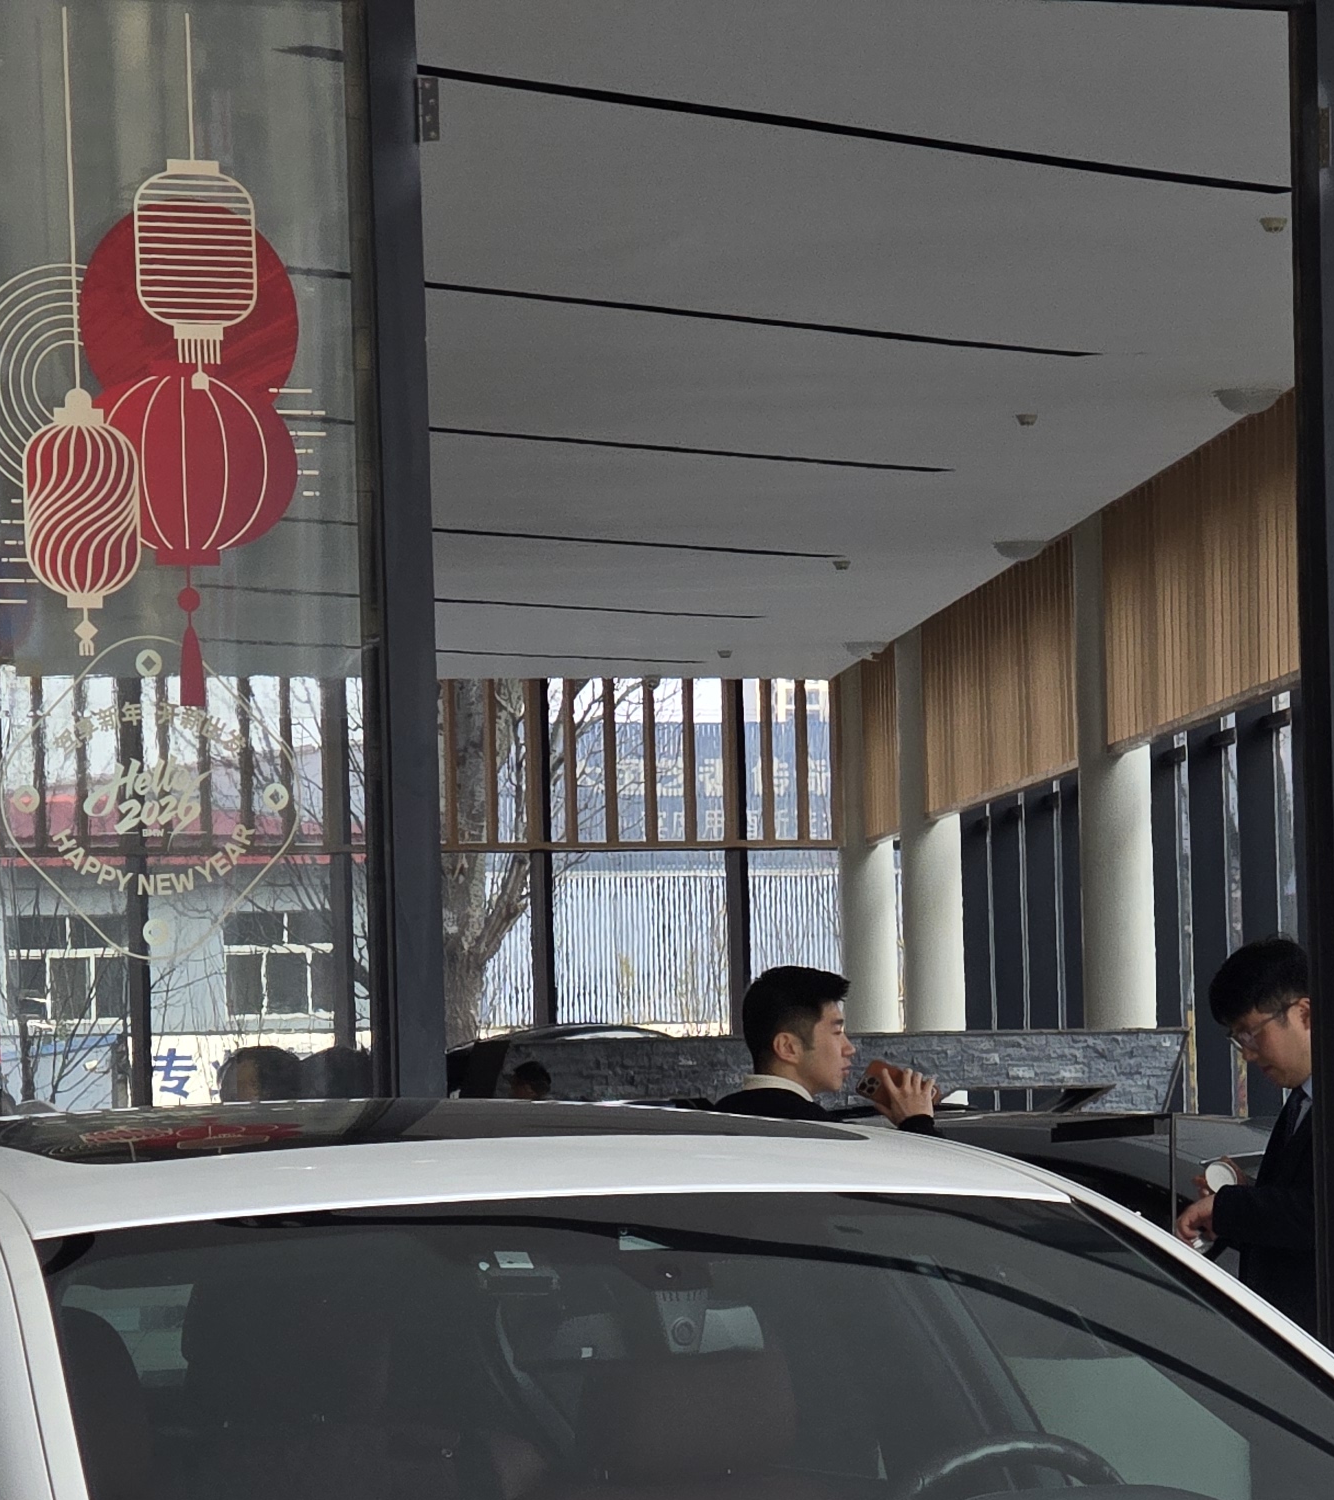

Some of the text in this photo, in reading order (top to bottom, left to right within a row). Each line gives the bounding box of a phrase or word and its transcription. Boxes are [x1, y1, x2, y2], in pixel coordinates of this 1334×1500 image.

[83, 755, 190, 816] Hello
[114, 775, 208, 842] 2026
[52, 823, 256, 895] HAPPY NEW YEAR
[153, 1047, 220, 1099] 专
